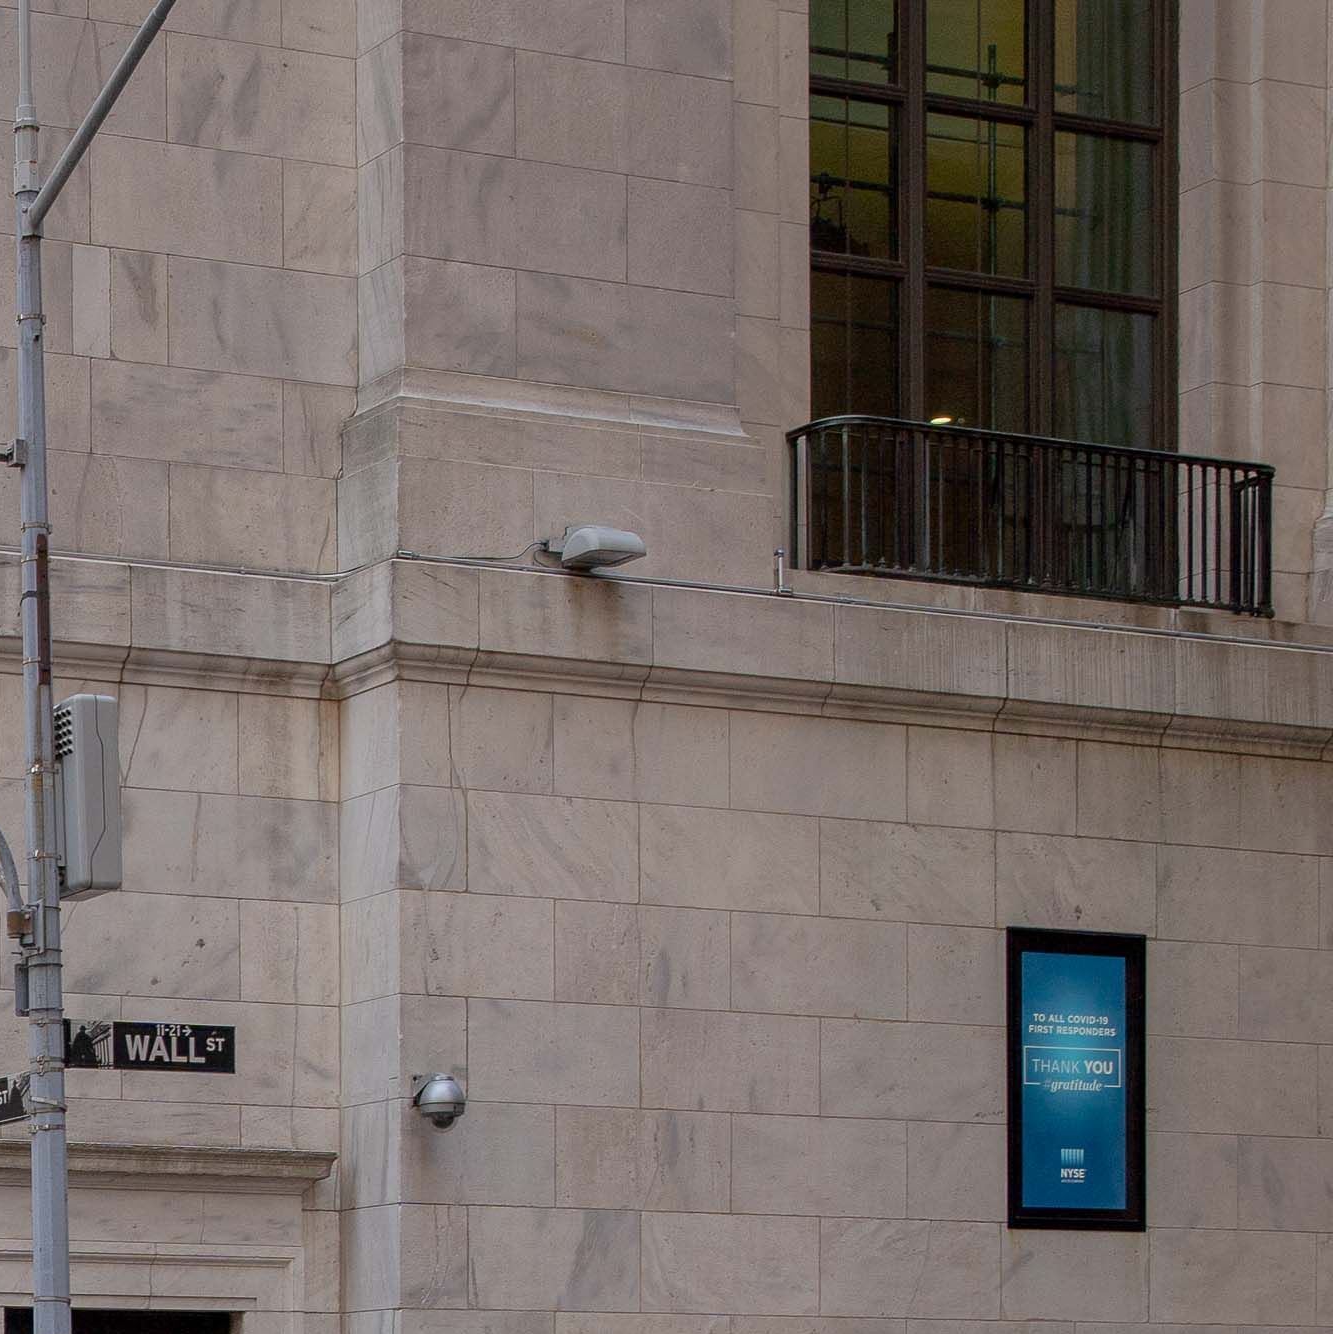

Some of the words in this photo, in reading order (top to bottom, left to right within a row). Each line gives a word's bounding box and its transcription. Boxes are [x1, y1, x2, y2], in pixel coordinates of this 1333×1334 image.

[1033, 1013, 1046, 1022] TO
[1049, 1014, 1065, 1023] ALL
[1067, 1015, 1109, 1025] COVID-19
[156, 1024, 180, 1037] 11-21
[1028, 1025, 1054, 1034] FIRST
[1056, 1025, 1116, 1037] RESPONDERS
[125, 1034, 206, 1063] WALL
[206, 1037, 226, 1052] ST
[1031, 1058, 1082, 1074] THANK
[1084, 1060, 1114, 1075] YOU
[1043, 1078, 1103, 1093] #gratitude
[1060, 1168, 1085, 1179] NYSE
